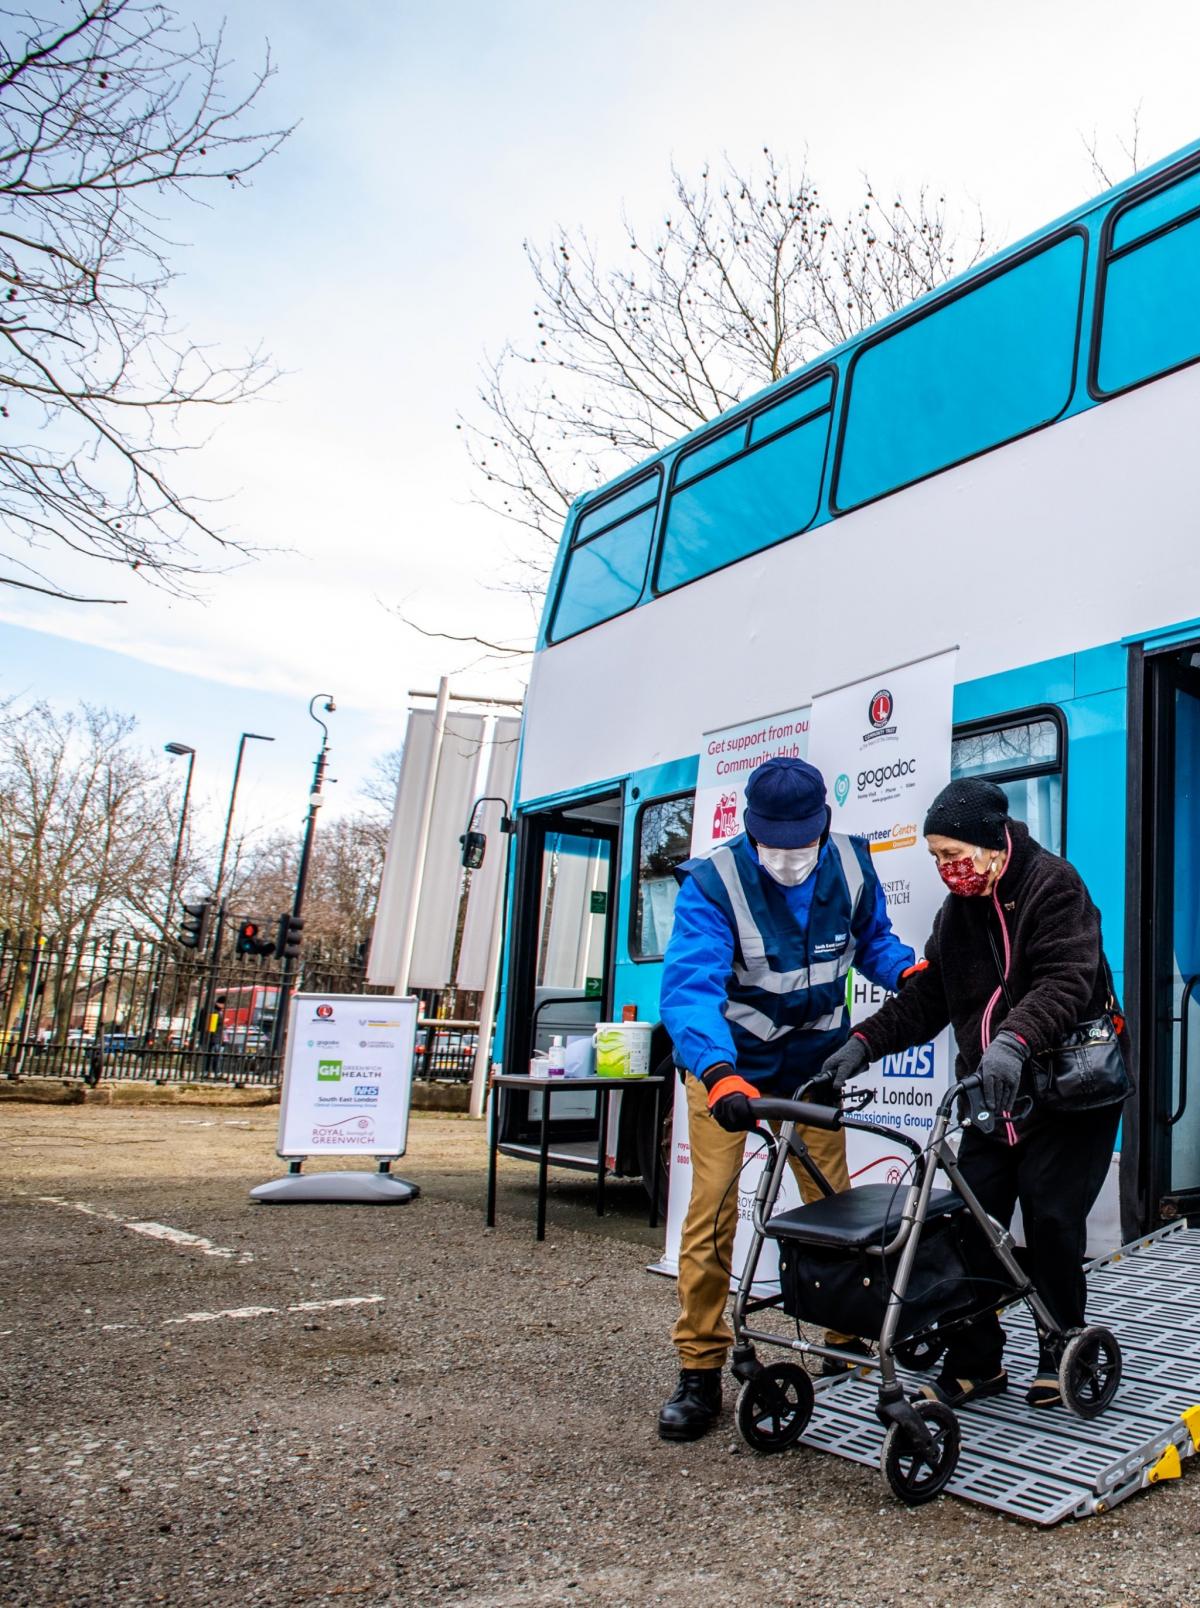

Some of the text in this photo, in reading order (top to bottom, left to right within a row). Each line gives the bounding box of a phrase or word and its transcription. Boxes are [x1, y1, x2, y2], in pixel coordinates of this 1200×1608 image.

[707, 720, 809, 756] Get support from ou
[777, 742, 800, 759] Hub
[857, 758, 916, 791] gogodoc
[882, 879, 905, 892] RSITY
[884, 1043, 932, 1076] NHS
[320, 1065, 341, 1076] GH
[355, 1086, 378, 1095] NHS
[882, 1086, 933, 1107] London
[903, 1113, 934, 1131] Group
[311, 1136, 375, 1144] GREENWICH
[312, 1128, 344, 1136] ROYAL
